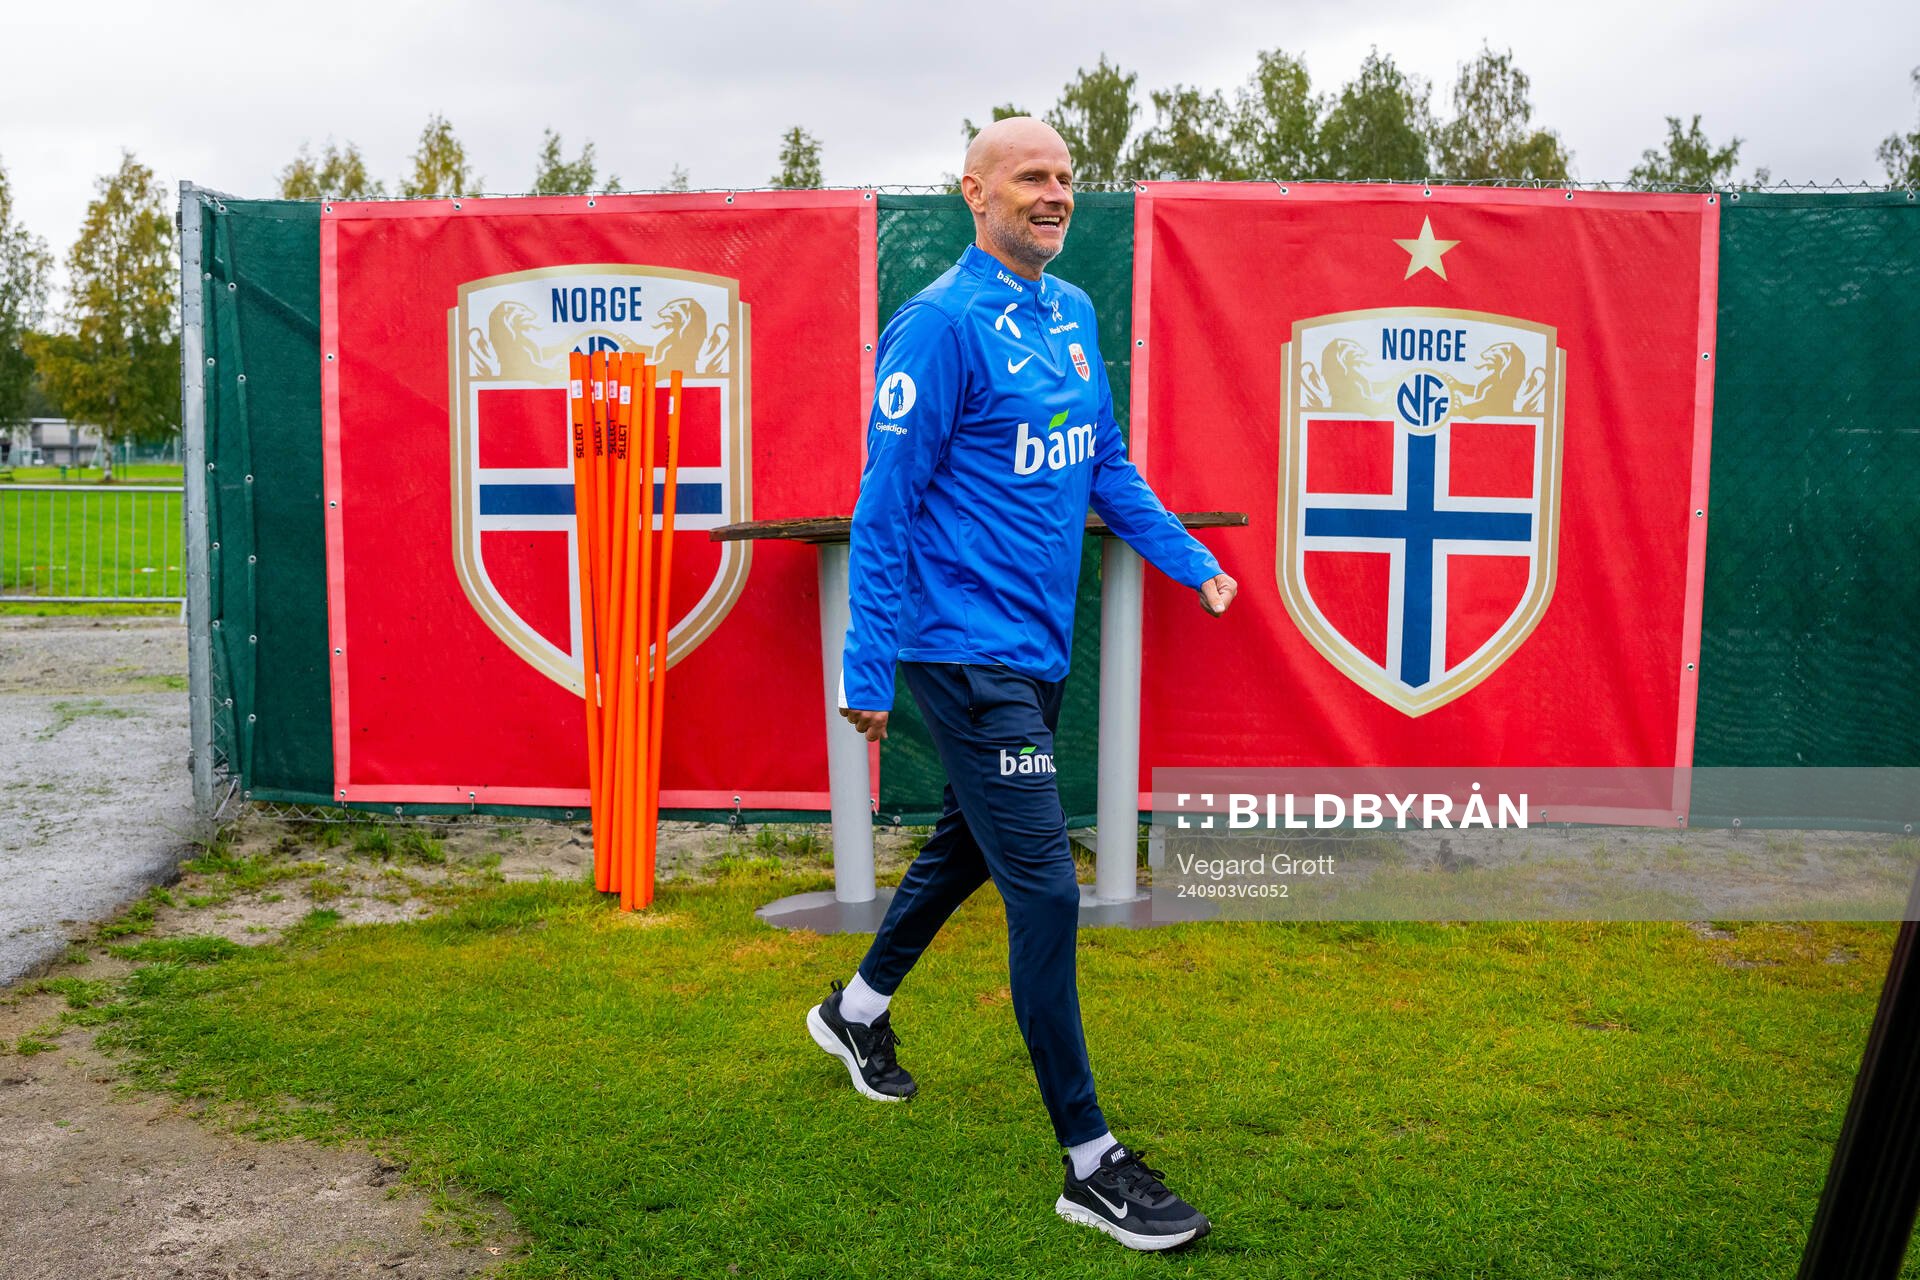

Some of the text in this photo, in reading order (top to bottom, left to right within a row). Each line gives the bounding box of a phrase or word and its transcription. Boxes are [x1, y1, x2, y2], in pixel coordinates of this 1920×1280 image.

[996, 270, 1023, 293] bama
[551, 286, 642, 323] NORGE
[1382, 328, 1467, 363] NORGE
[575, 423, 585, 459] SELECT
[617, 424, 628, 460] SELECT
[1110, 1147, 1126, 1164] NIKE
